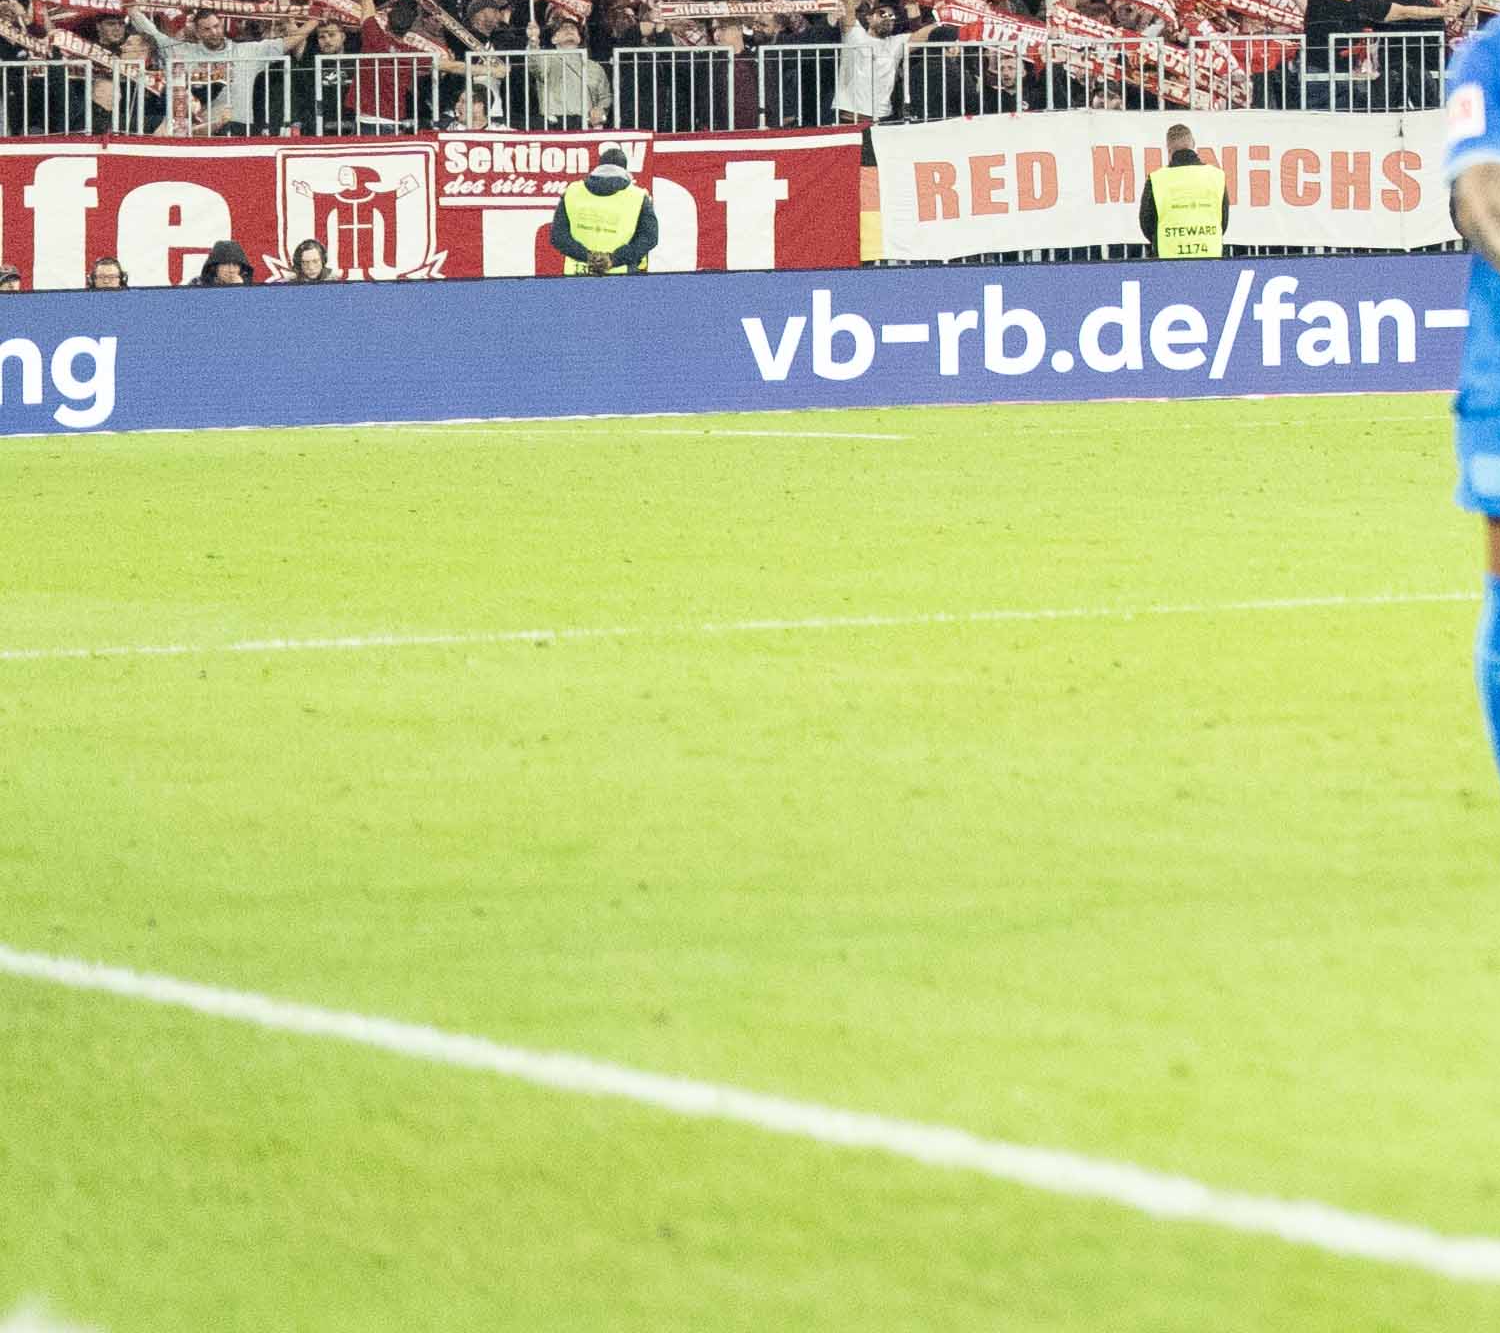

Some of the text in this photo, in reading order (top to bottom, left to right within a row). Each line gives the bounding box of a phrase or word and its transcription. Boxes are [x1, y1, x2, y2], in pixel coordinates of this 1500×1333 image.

[443, 140, 588, 176] Sektion
[914, 150, 1058, 223] RED
[1164, 225, 1217, 238] STEWARD
[1177, 243, 1209, 257] 1174
